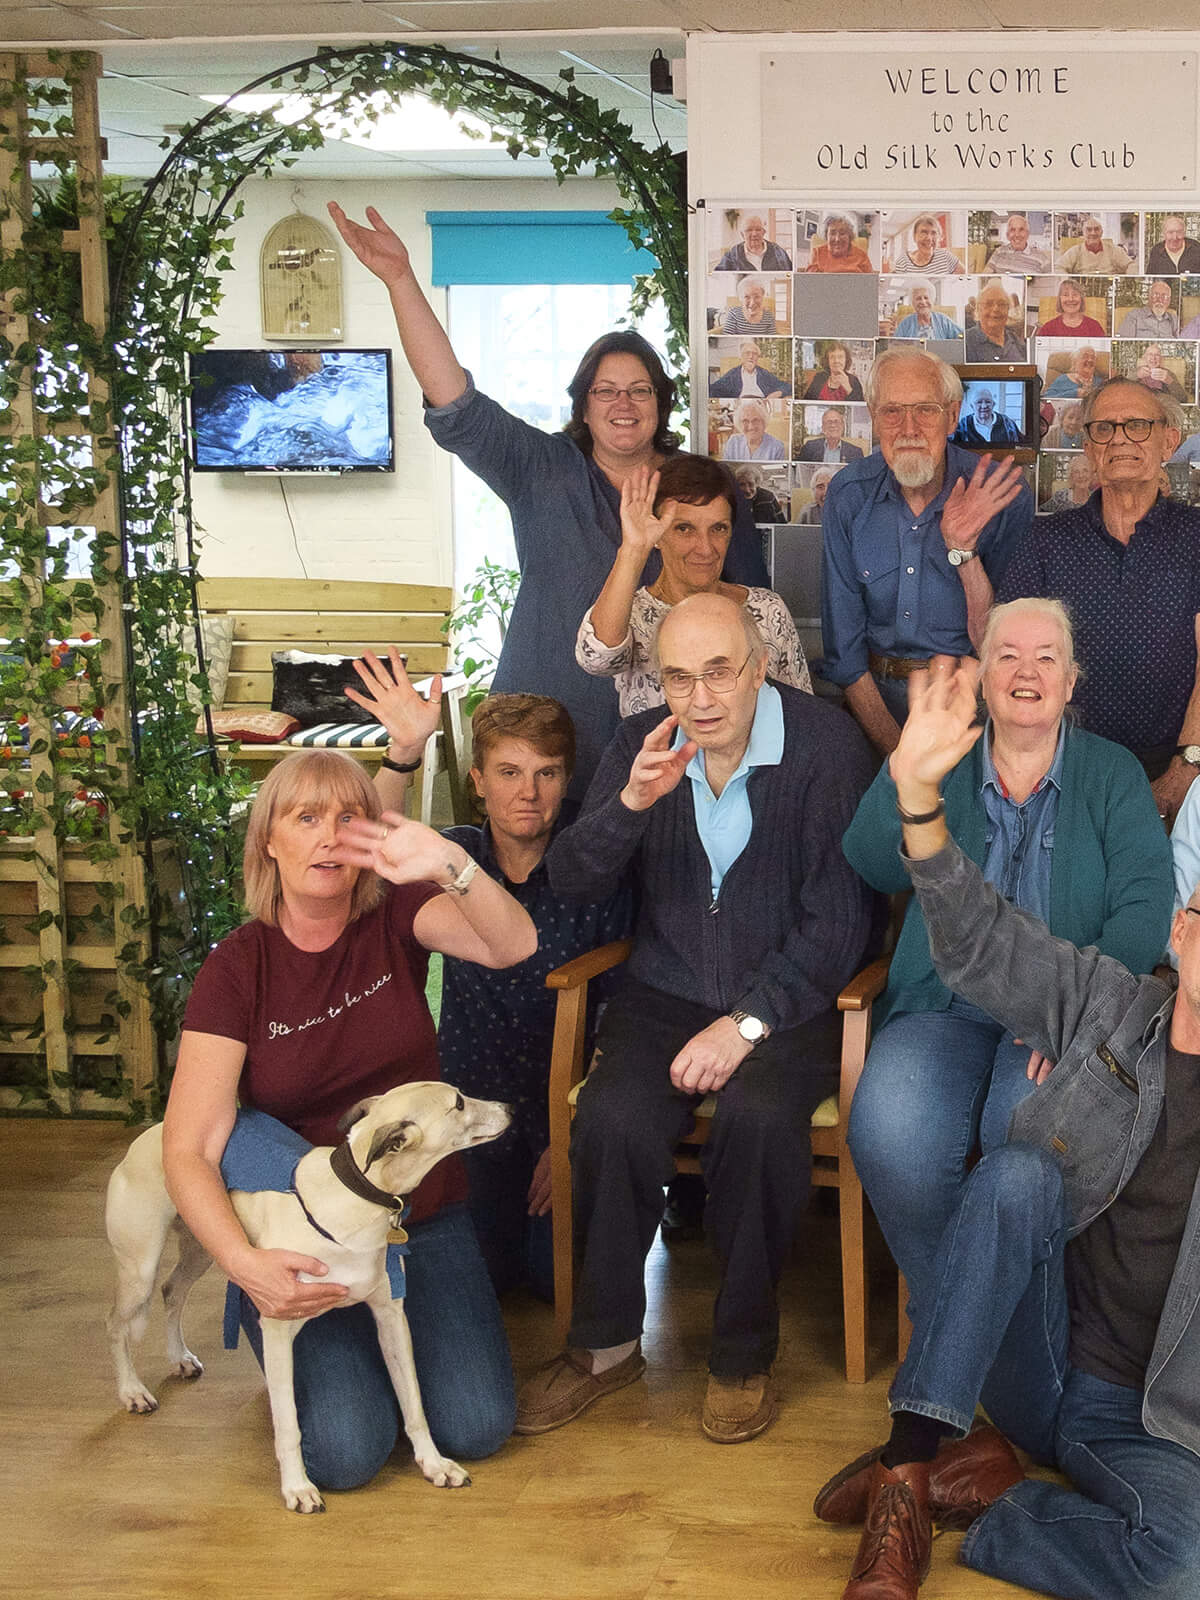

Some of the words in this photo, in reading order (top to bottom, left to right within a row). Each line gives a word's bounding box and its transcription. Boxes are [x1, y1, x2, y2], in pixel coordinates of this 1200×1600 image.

[884, 66, 1073, 95] WELCOME
[930, 108, 955, 133] to
[966, 108, 1011, 134] the
[953, 143, 1054, 171] Works
[1070, 143, 1138, 171] Club
[298, 1016, 325, 1031] nice
[328, 1006, 343, 1018] to
[345, 992, 361, 1007] be
[365, 973, 392, 997] nice
